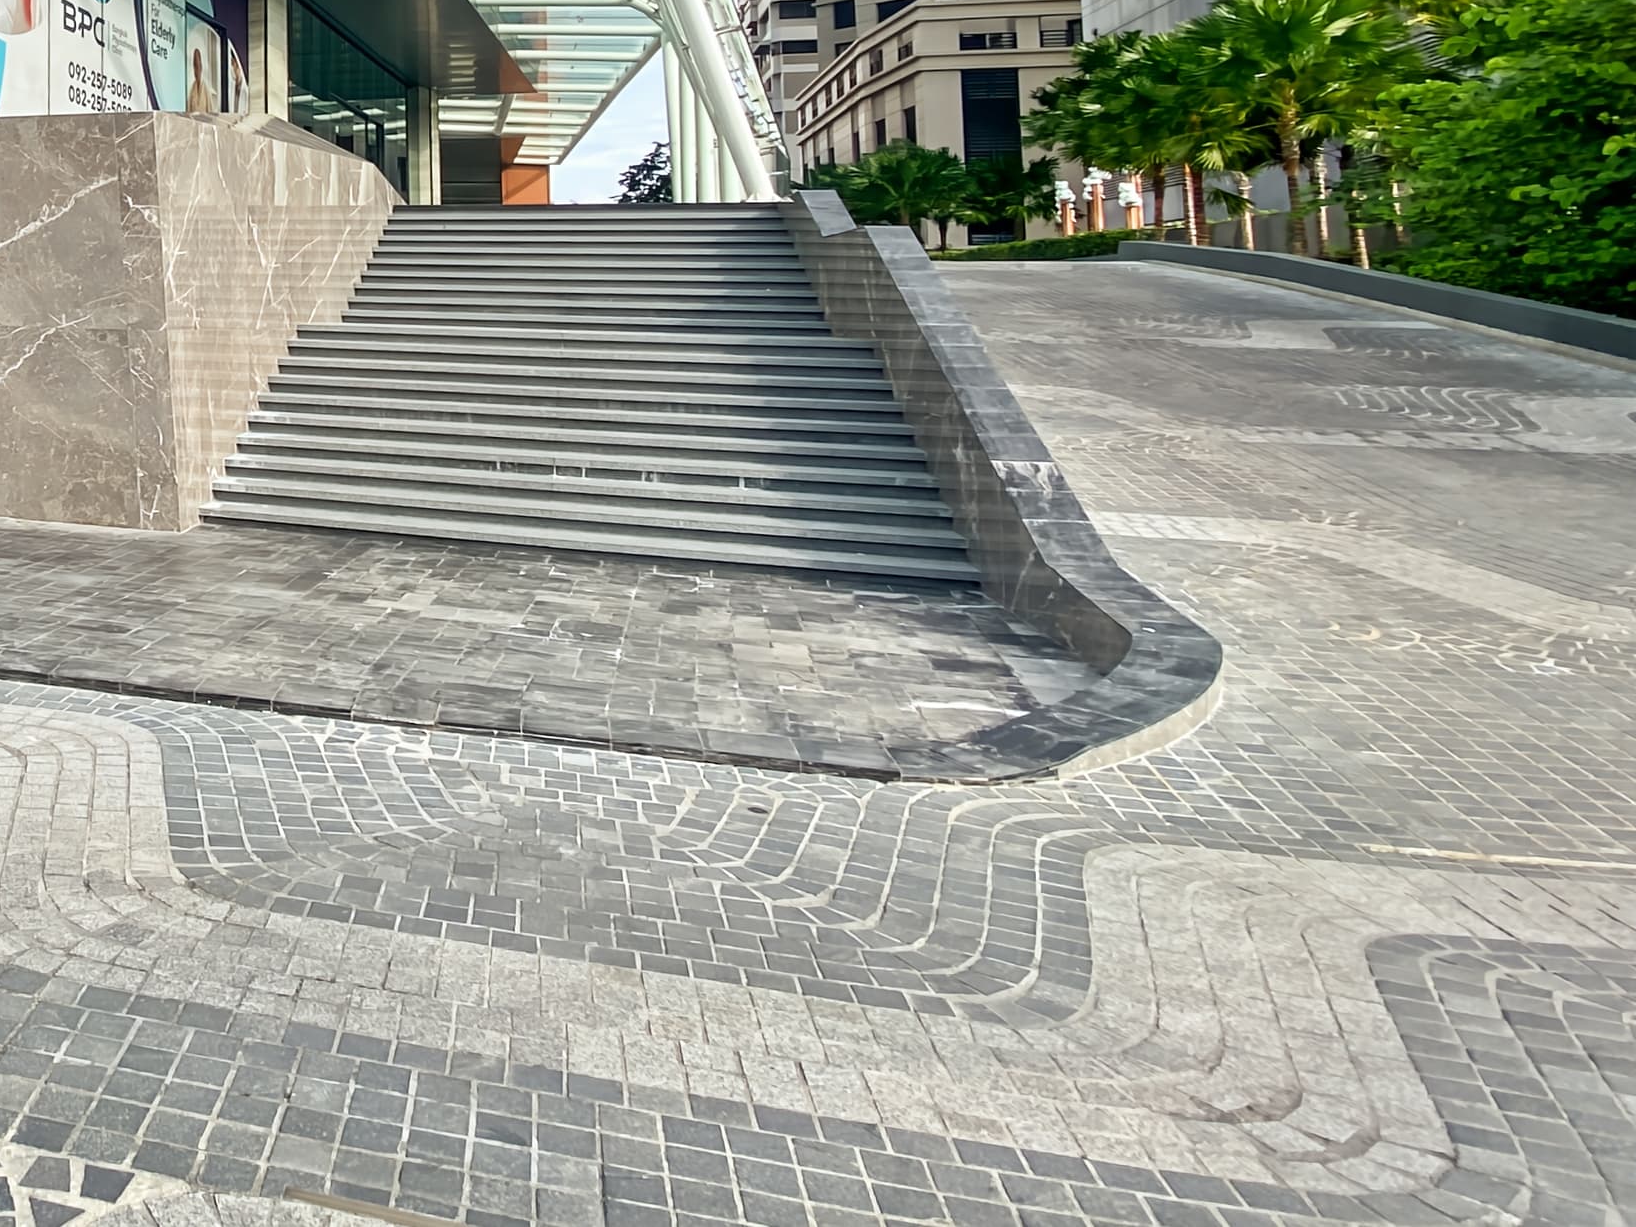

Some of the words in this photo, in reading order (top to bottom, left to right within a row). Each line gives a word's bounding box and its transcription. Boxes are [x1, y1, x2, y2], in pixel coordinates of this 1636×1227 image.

[151, 19, 176, 50] Elderly
[151, 38, 168, 60] Care
[68, 61, 132, 102] 092-257-5089
